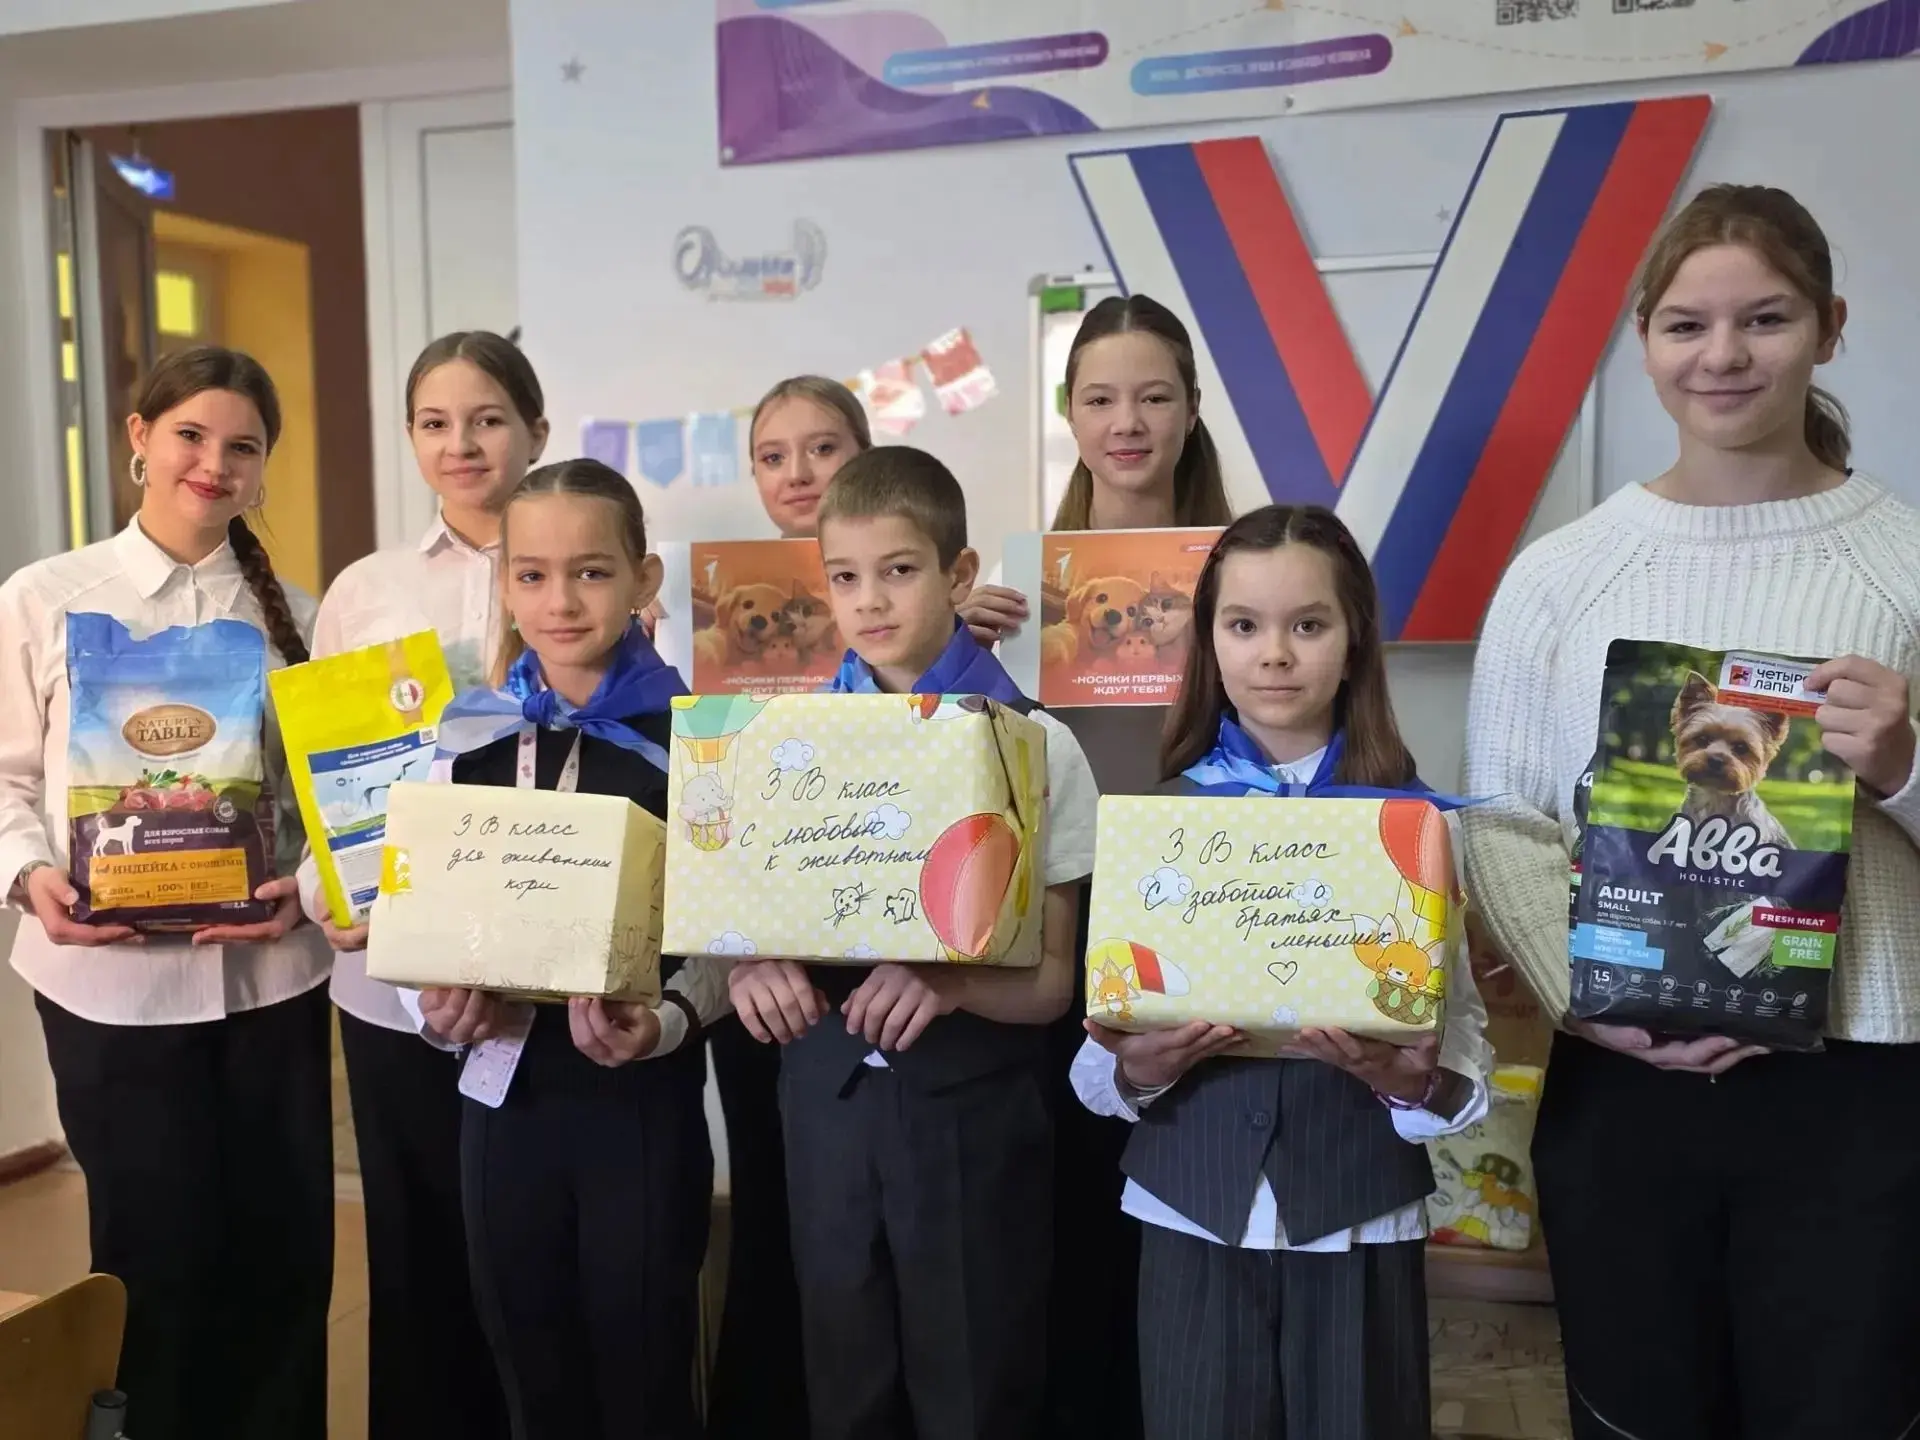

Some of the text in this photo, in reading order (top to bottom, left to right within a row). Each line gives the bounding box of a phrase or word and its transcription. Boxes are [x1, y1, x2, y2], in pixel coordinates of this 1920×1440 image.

[1093, 685, 1167, 695] ЖДУТ ТЕБЯ!
[136, 725, 201, 742] TABLE
[761, 766, 911, 801] 3 В класс
[453, 813, 579, 836] 3 В класс
[772, 812, 886, 848] любовью
[1161, 827, 1340, 864] 3 В класс
[112, 861, 178, 875] ИНДЕЙКА
[1679, 872, 1745, 888] HOLISTIC
[1182, 878, 1294, 924] заботой
[1599, 885, 1664, 905] ADULT
[1598, 900, 1631, 912] SMALL
[1235, 905, 1354, 941] братьях
[1760, 913, 1826, 927] FRESH MEAT
[1270, 930, 1392, 949] меньших
[1782, 935, 1823, 949] GRAIN
[1788, 947, 1822, 961] FREE
